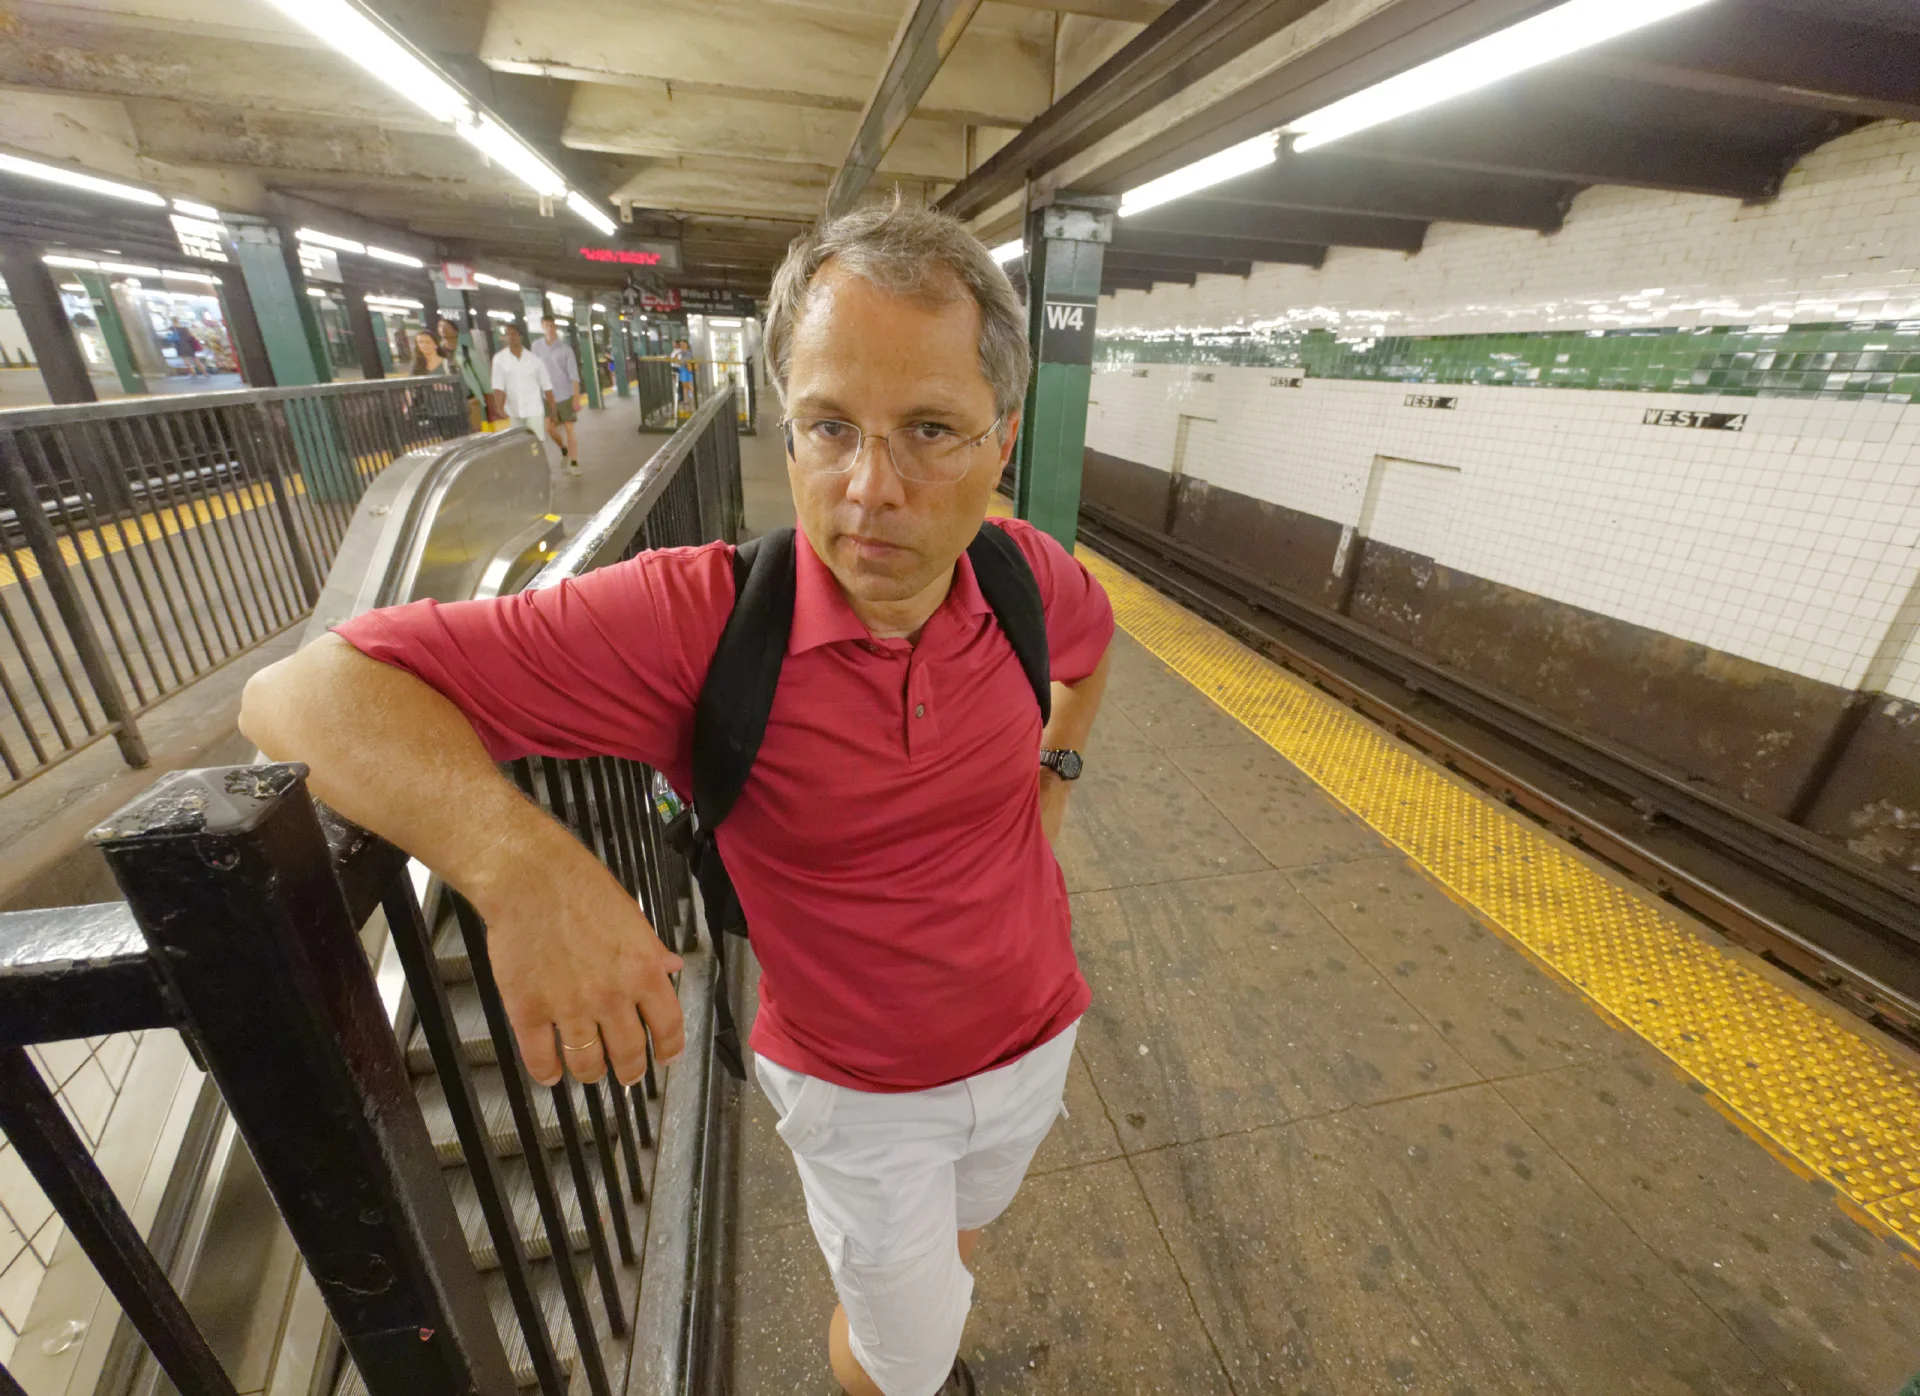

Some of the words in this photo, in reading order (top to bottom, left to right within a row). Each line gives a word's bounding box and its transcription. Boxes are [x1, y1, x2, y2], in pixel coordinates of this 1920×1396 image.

[1046, 305, 1084, 331] W4
[1446, 397, 1458, 410] 4
[1645, 409, 1711, 428] WEST
[1724, 414, 1746, 431] 4
